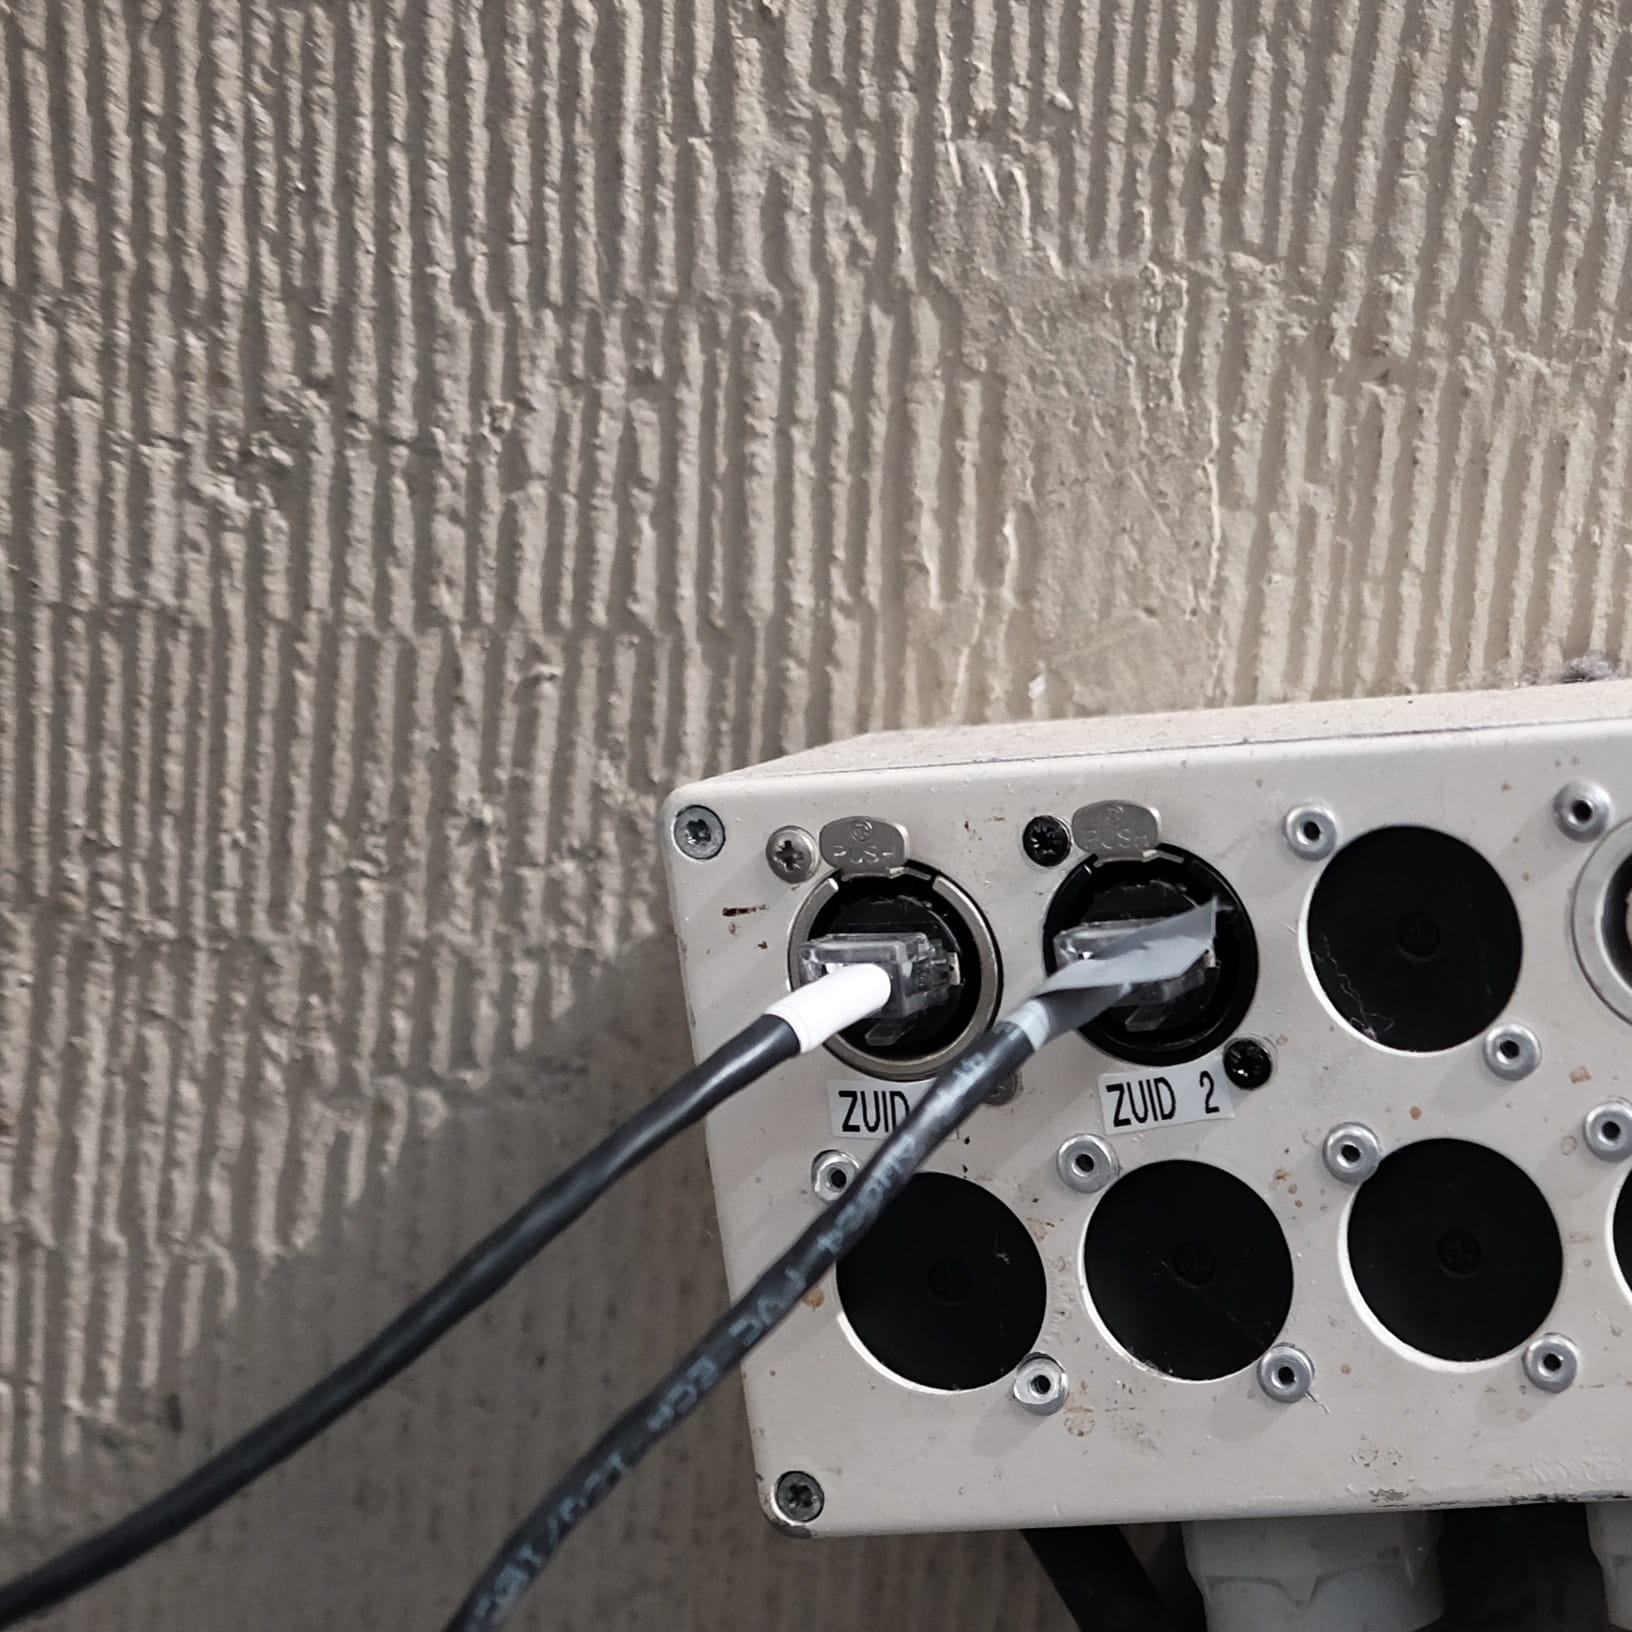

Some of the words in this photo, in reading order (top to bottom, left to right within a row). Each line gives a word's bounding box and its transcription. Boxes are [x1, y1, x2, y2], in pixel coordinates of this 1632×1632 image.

[838, 1089, 910, 1134] ZUID
[1105, 1076, 1177, 1128] ZUID
[1199, 1069, 1220, 1115] 2
